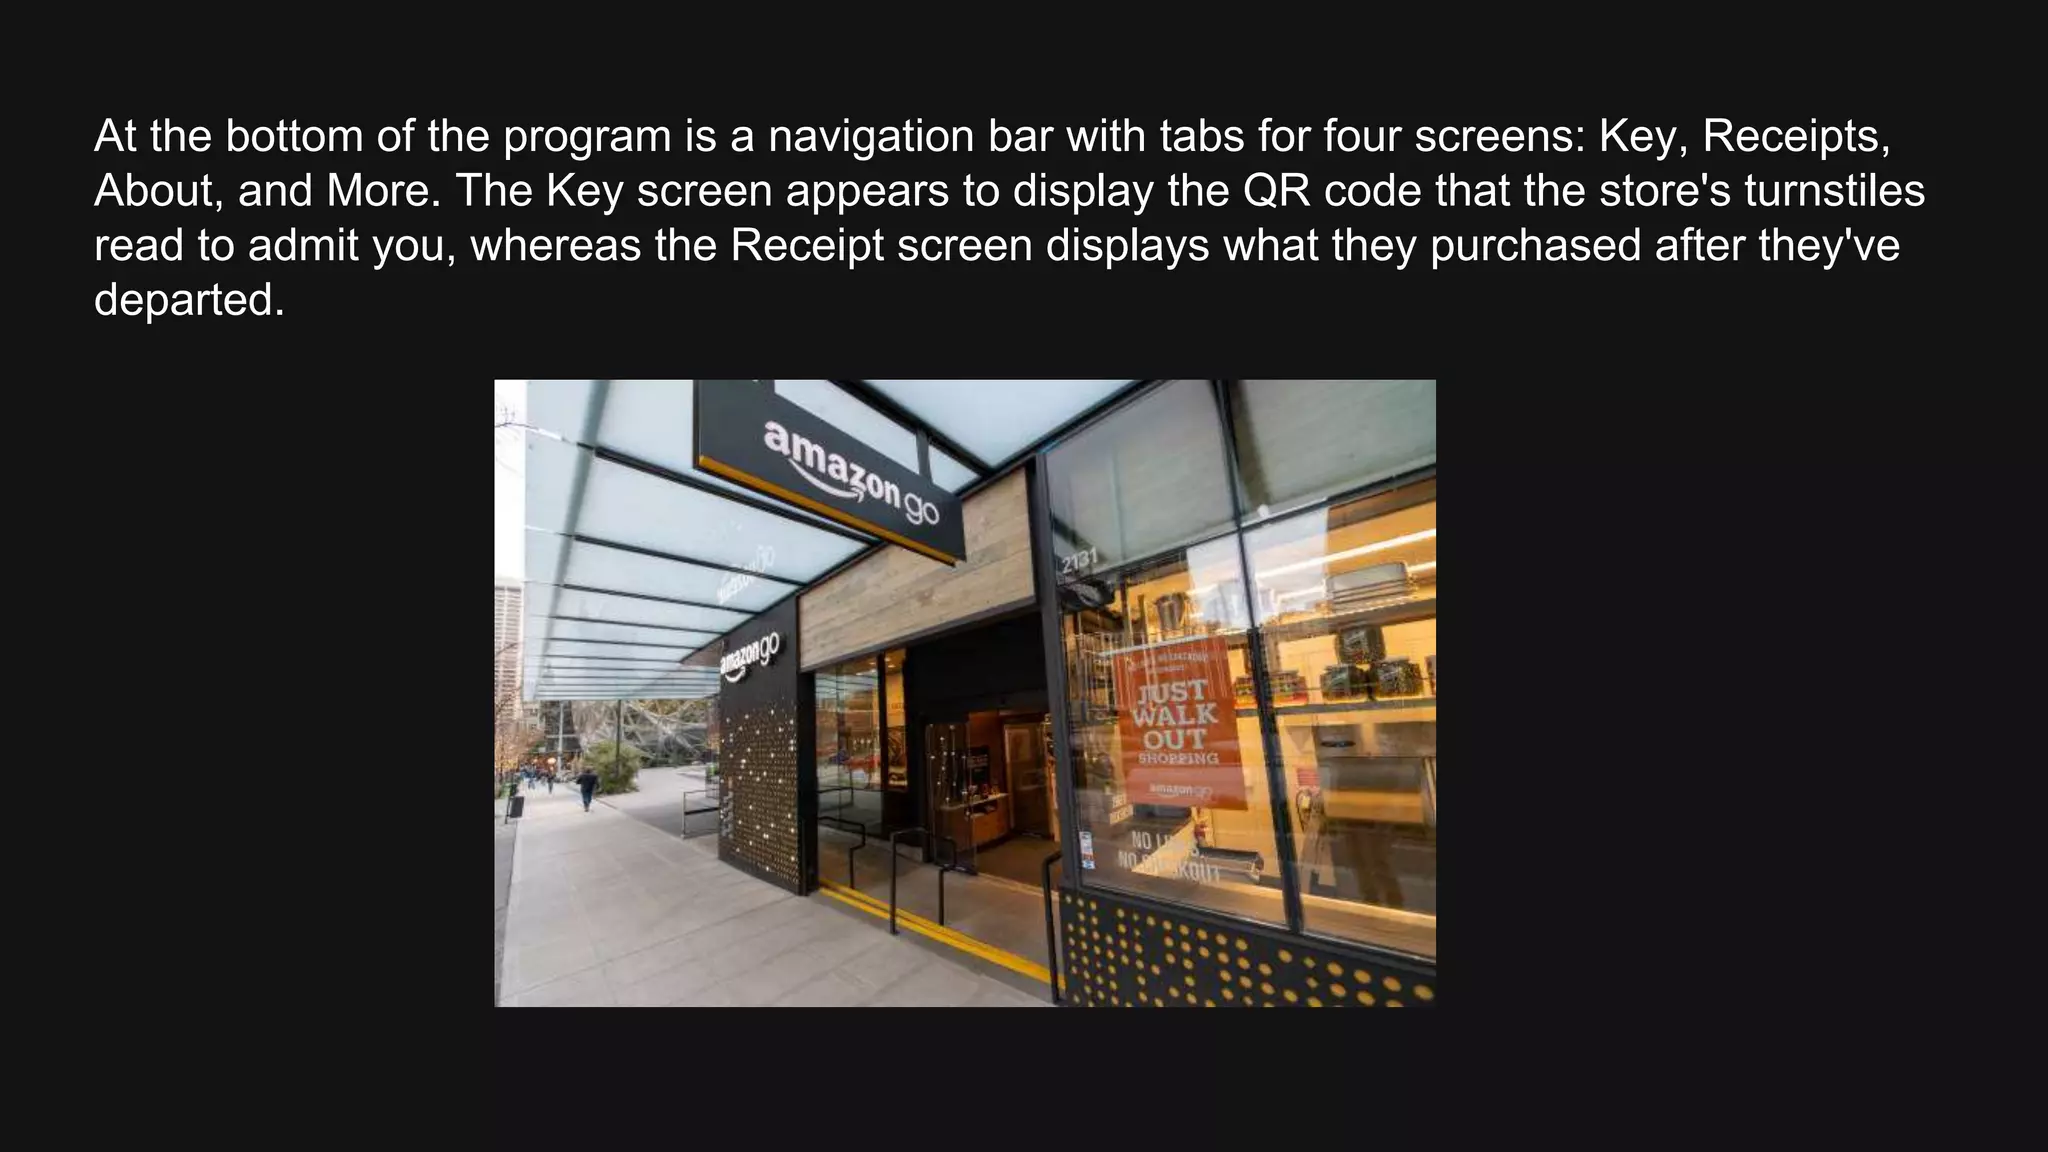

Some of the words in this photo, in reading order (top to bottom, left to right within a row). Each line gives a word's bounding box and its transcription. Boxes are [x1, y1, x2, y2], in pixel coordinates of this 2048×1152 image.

[763, 420, 901, 509] amazon
[904, 492, 941, 526] go
[1061, 546, 1097, 574] 2131
[720, 640, 760, 683] amazon
[760, 631, 780, 666] go
[1137, 678, 1209, 705] JUST
[1132, 702, 1219, 728] WALK
[1142, 728, 1208, 751] OUT
[1138, 751, 1220, 765] SHOPPING
[1131, 829, 1153, 850] NO
[1117, 848, 1138, 869] NO
